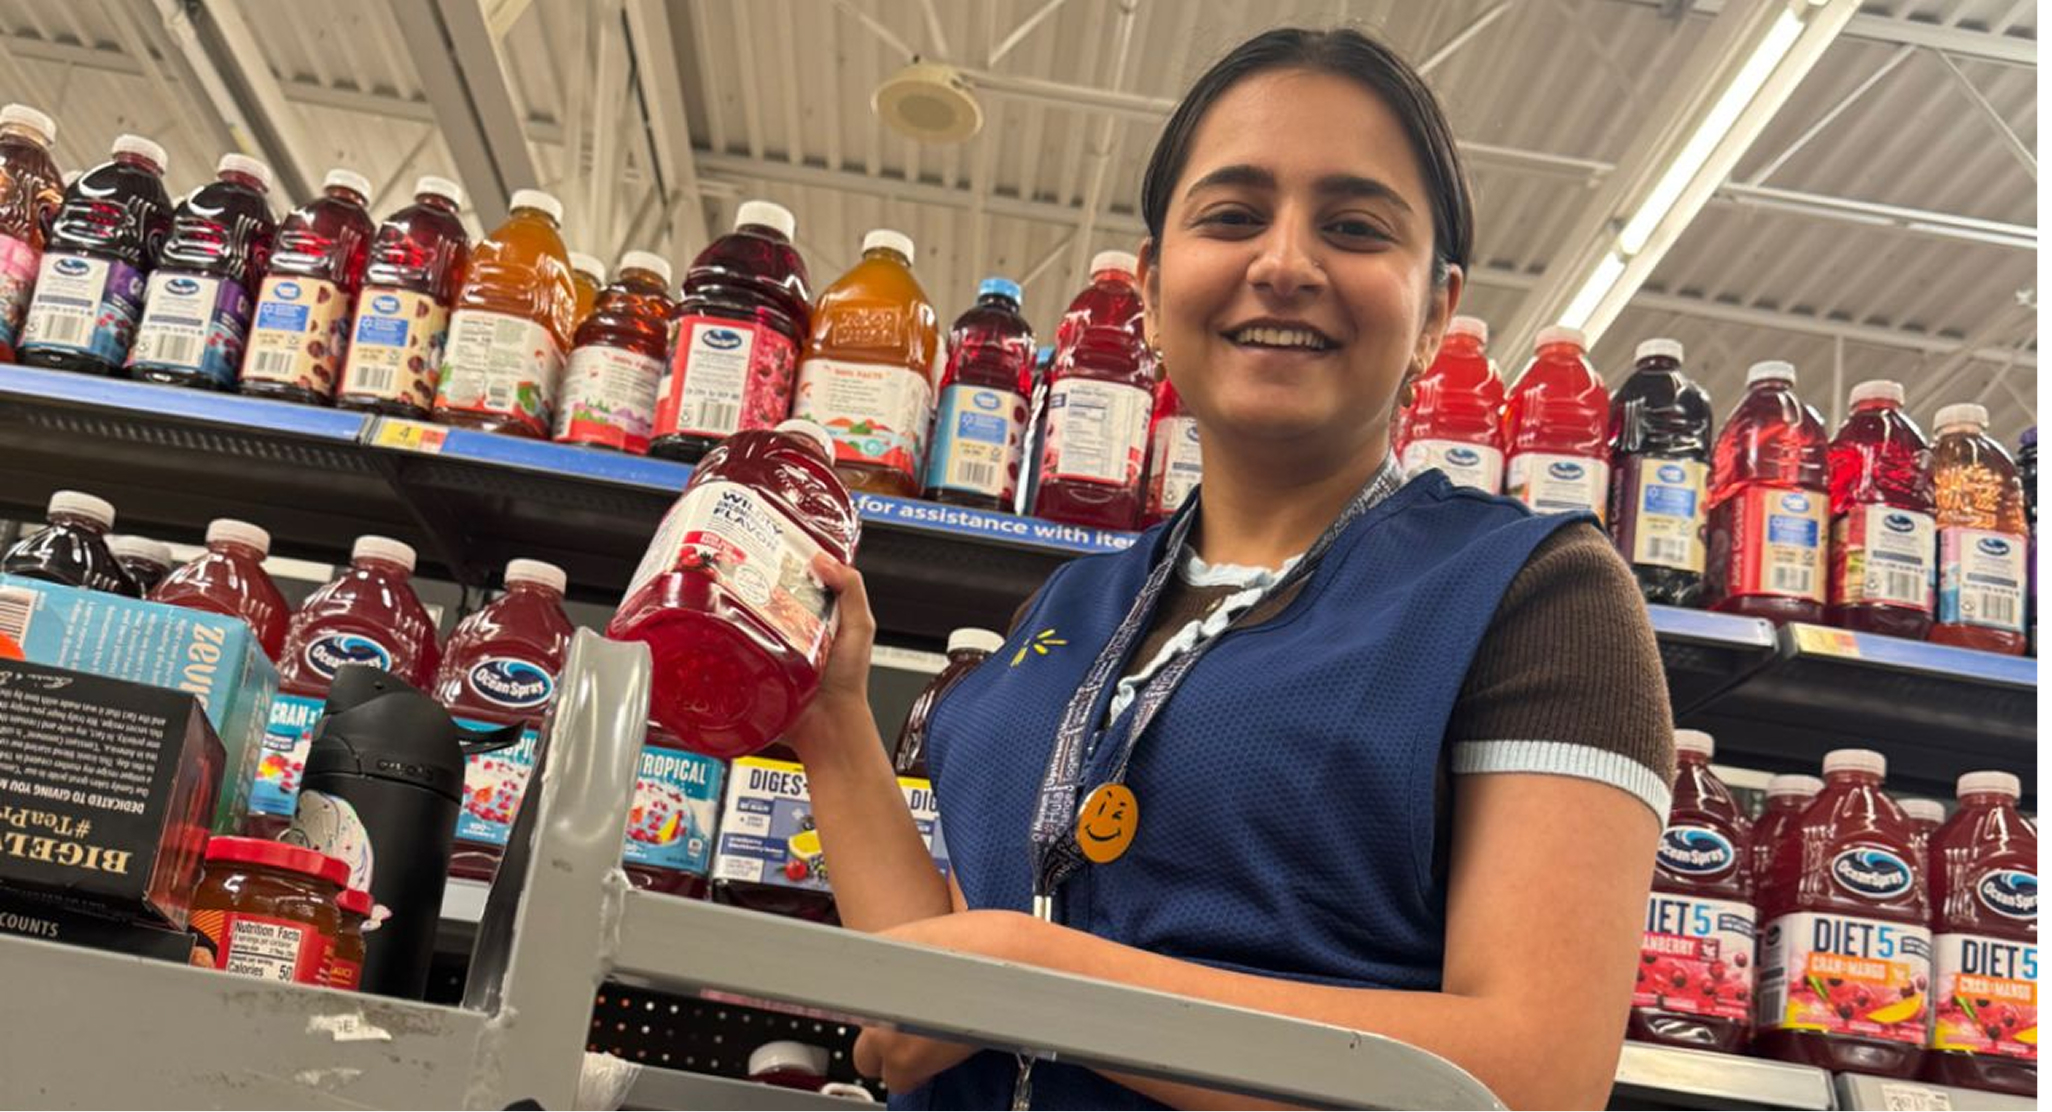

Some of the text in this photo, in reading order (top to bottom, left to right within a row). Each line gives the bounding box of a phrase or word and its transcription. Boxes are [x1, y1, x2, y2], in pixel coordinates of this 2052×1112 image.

[859, 495, 894, 513] for
[900, 502, 1028, 535] assistance
[1034, 524, 1089, 546] with
[476, 668, 544, 699] Ocean Spray
[270, 701, 308, 727] CRAN
[9, 779, 145, 814] DEDICATED TO GIVING YOU
[1043, 788, 1064, 824] Hula
[0, 831, 133, 875] BIGEL
[1691, 848, 1725, 867] Spray
[1838, 859, 1904, 890] Ocean Spray
[1983, 881, 2015, 906] Ocean
[235, 921, 274, 937] Nutrition
[1693, 905, 1711, 936] 5
[1814, 918, 1875, 959] DIET
[1878, 926, 1894, 958] 5
[229, 961, 292, 981] Calories 50
[1961, 939, 2019, 979] DIET
[2022, 947, 2037, 980] 5
